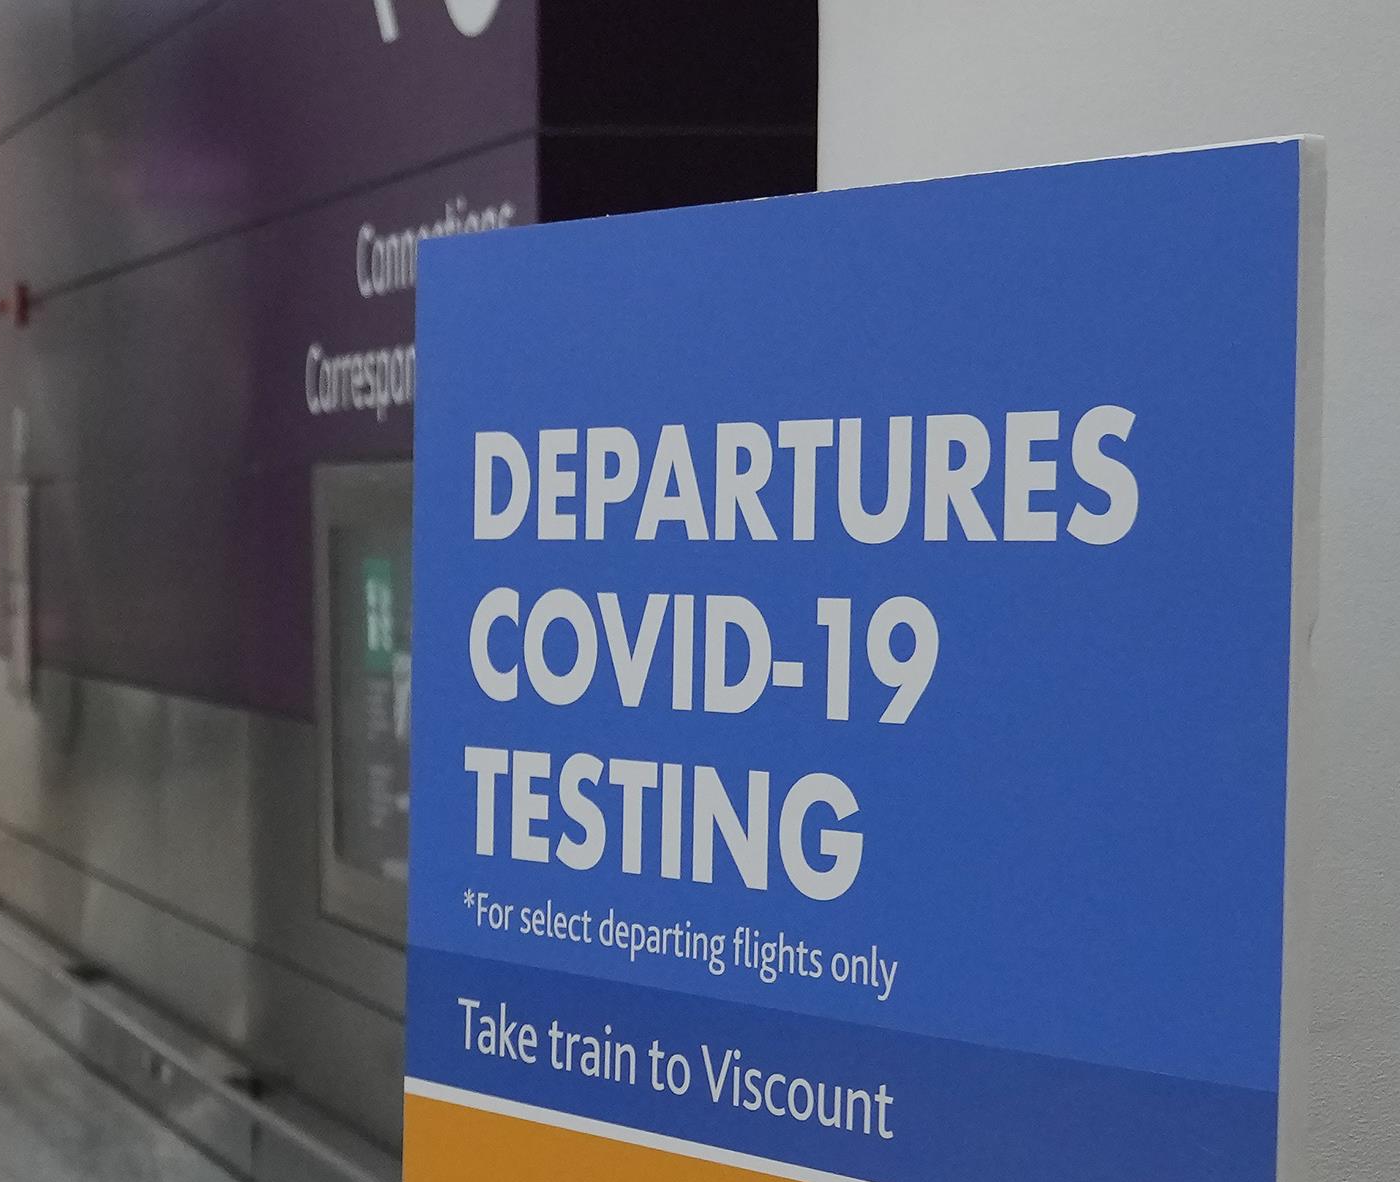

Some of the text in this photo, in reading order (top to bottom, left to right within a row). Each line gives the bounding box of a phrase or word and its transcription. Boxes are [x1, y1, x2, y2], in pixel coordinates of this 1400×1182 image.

[305, 343, 416, 422] Correspon
[473, 404, 1139, 545] DEPARTURES
[469, 586, 940, 725] COVID-19
[463, 745, 864, 908] TESTING
[519, 899, 592, 944] select
[598, 908, 726, 976] departing
[732, 926, 823, 984] flights
[831, 945, 898, 1001] only
[457, 997, 894, 1139] Take train to Viscount
